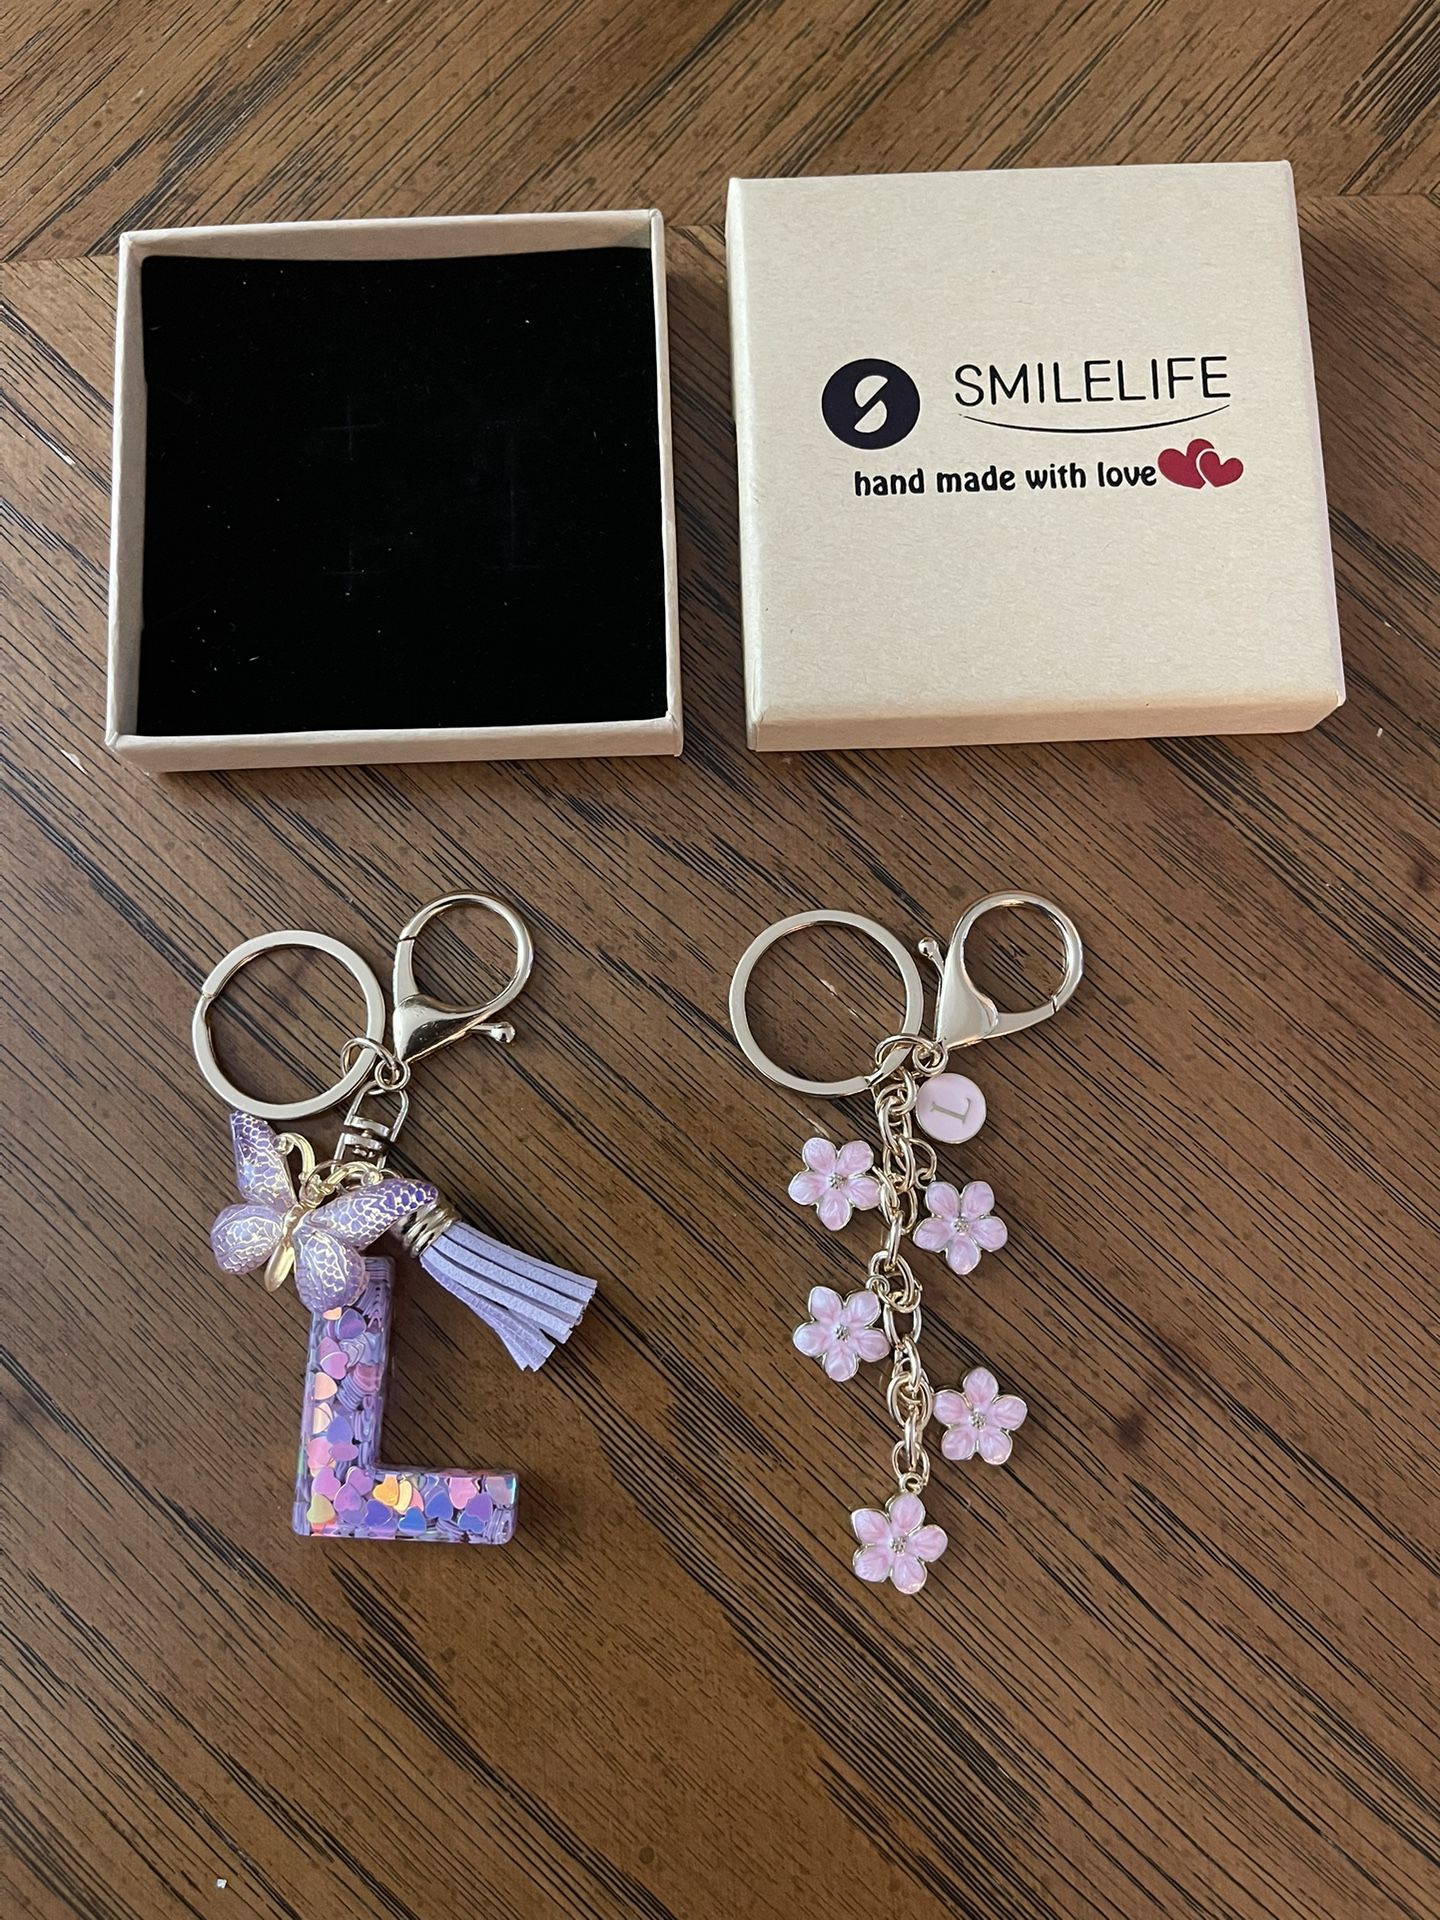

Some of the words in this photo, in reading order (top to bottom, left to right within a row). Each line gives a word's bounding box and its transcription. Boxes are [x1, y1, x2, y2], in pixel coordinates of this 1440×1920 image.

[954, 356, 1231, 407] SMILELIFE
[854, 467, 925, 497] hand
[936, 465, 1016, 493] made
[1025, 462, 1087, 490] with
[1097, 461, 1157, 488] love
[929, 1097, 972, 1125] L
[292, 1256, 520, 1545] L
